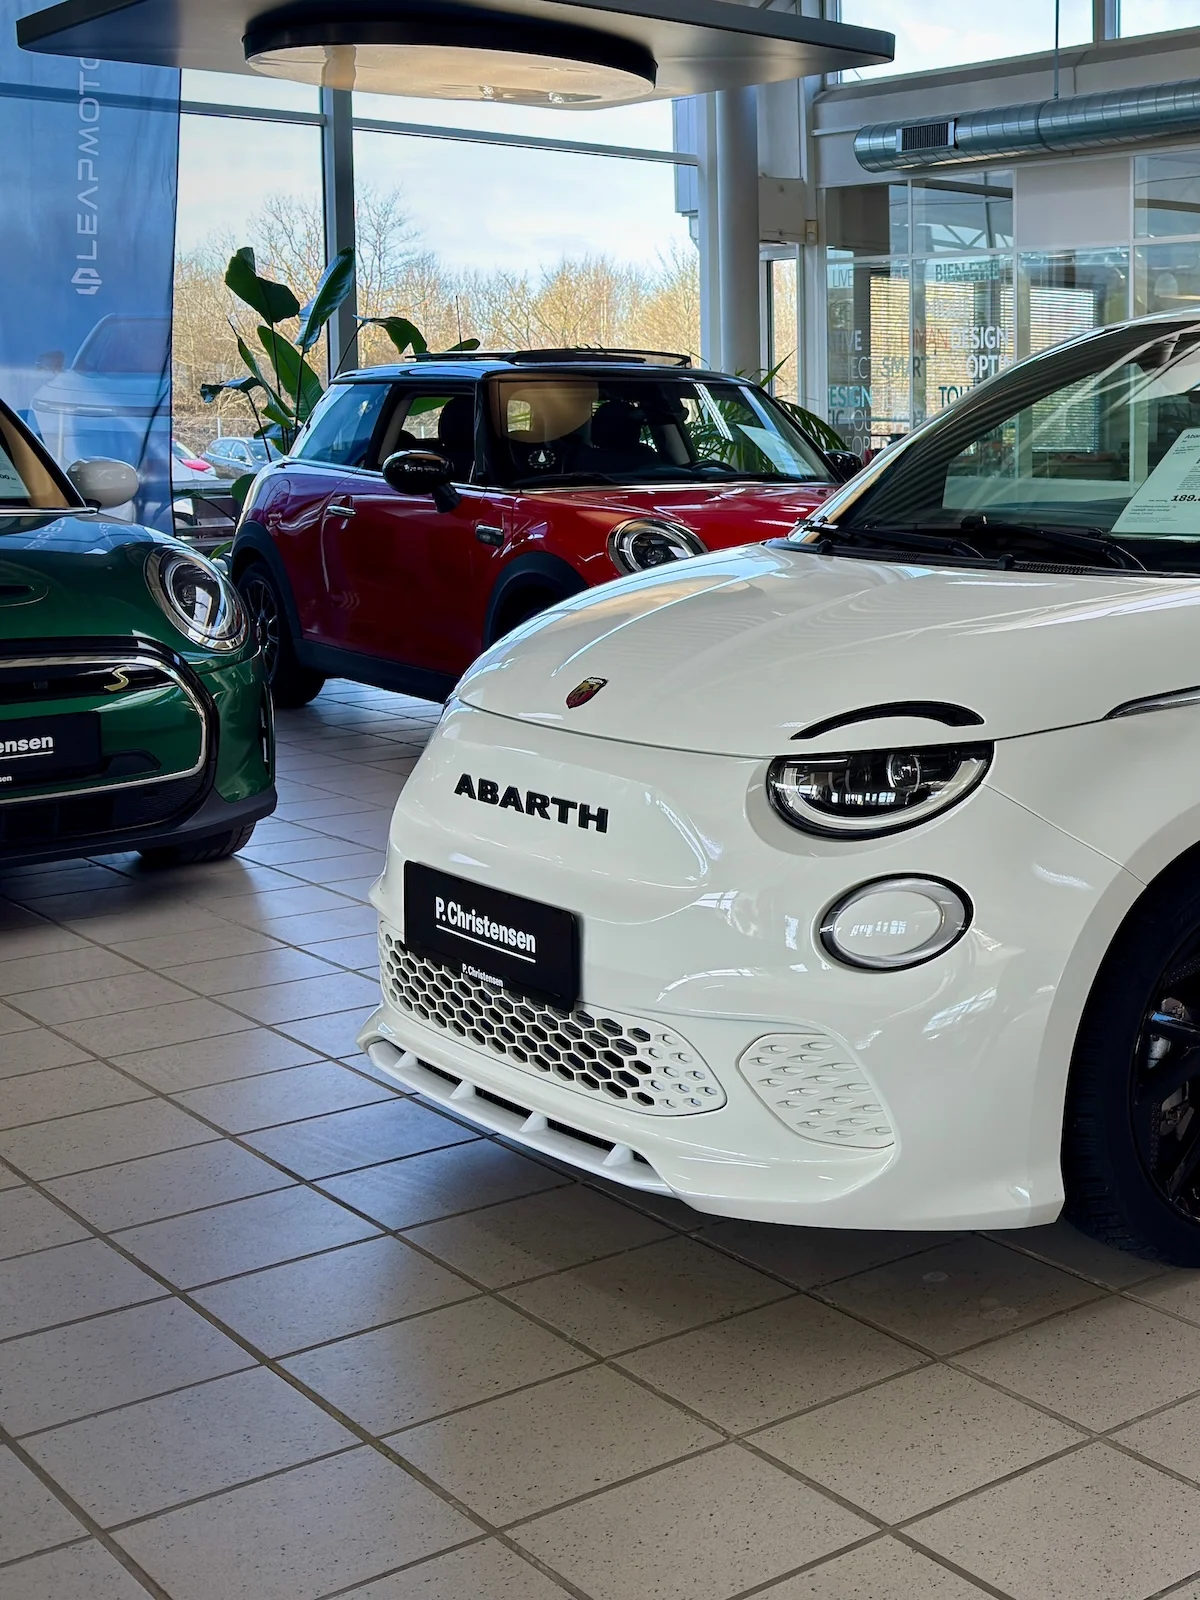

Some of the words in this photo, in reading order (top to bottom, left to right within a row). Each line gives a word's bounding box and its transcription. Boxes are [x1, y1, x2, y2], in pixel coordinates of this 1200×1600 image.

[454, 773, 609, 834] ABARTH
[447, 901, 536, 954] Christensen
[468, 965, 504, 988] Christensen
